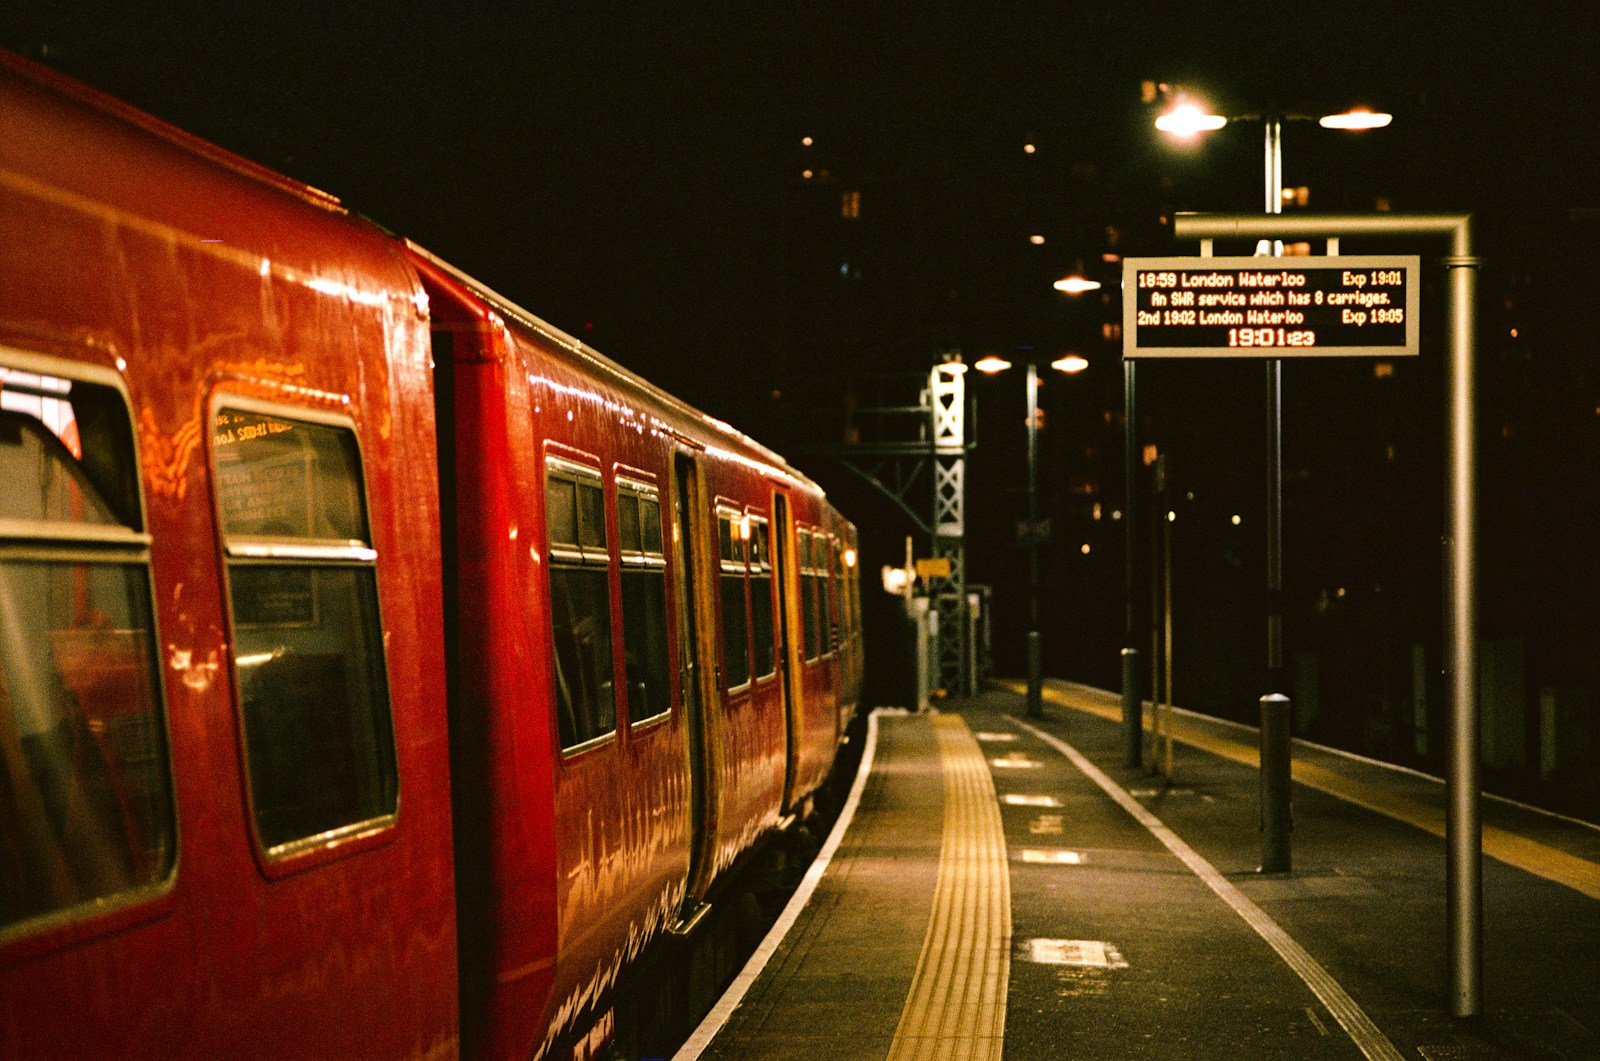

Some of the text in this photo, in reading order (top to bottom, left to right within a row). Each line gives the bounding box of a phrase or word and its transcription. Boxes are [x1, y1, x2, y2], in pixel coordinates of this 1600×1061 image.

[1138, 271, 1403, 288] 18:59 London Waterloo Exp 19:01
[1150, 290, 1391, 308] An SWR service which has 8 carriages.
[1136, 308, 1404, 326] 2nd 19:02 London Waterloo Exp 19:05
[1228, 328, 1316, 346] 19:01:23
